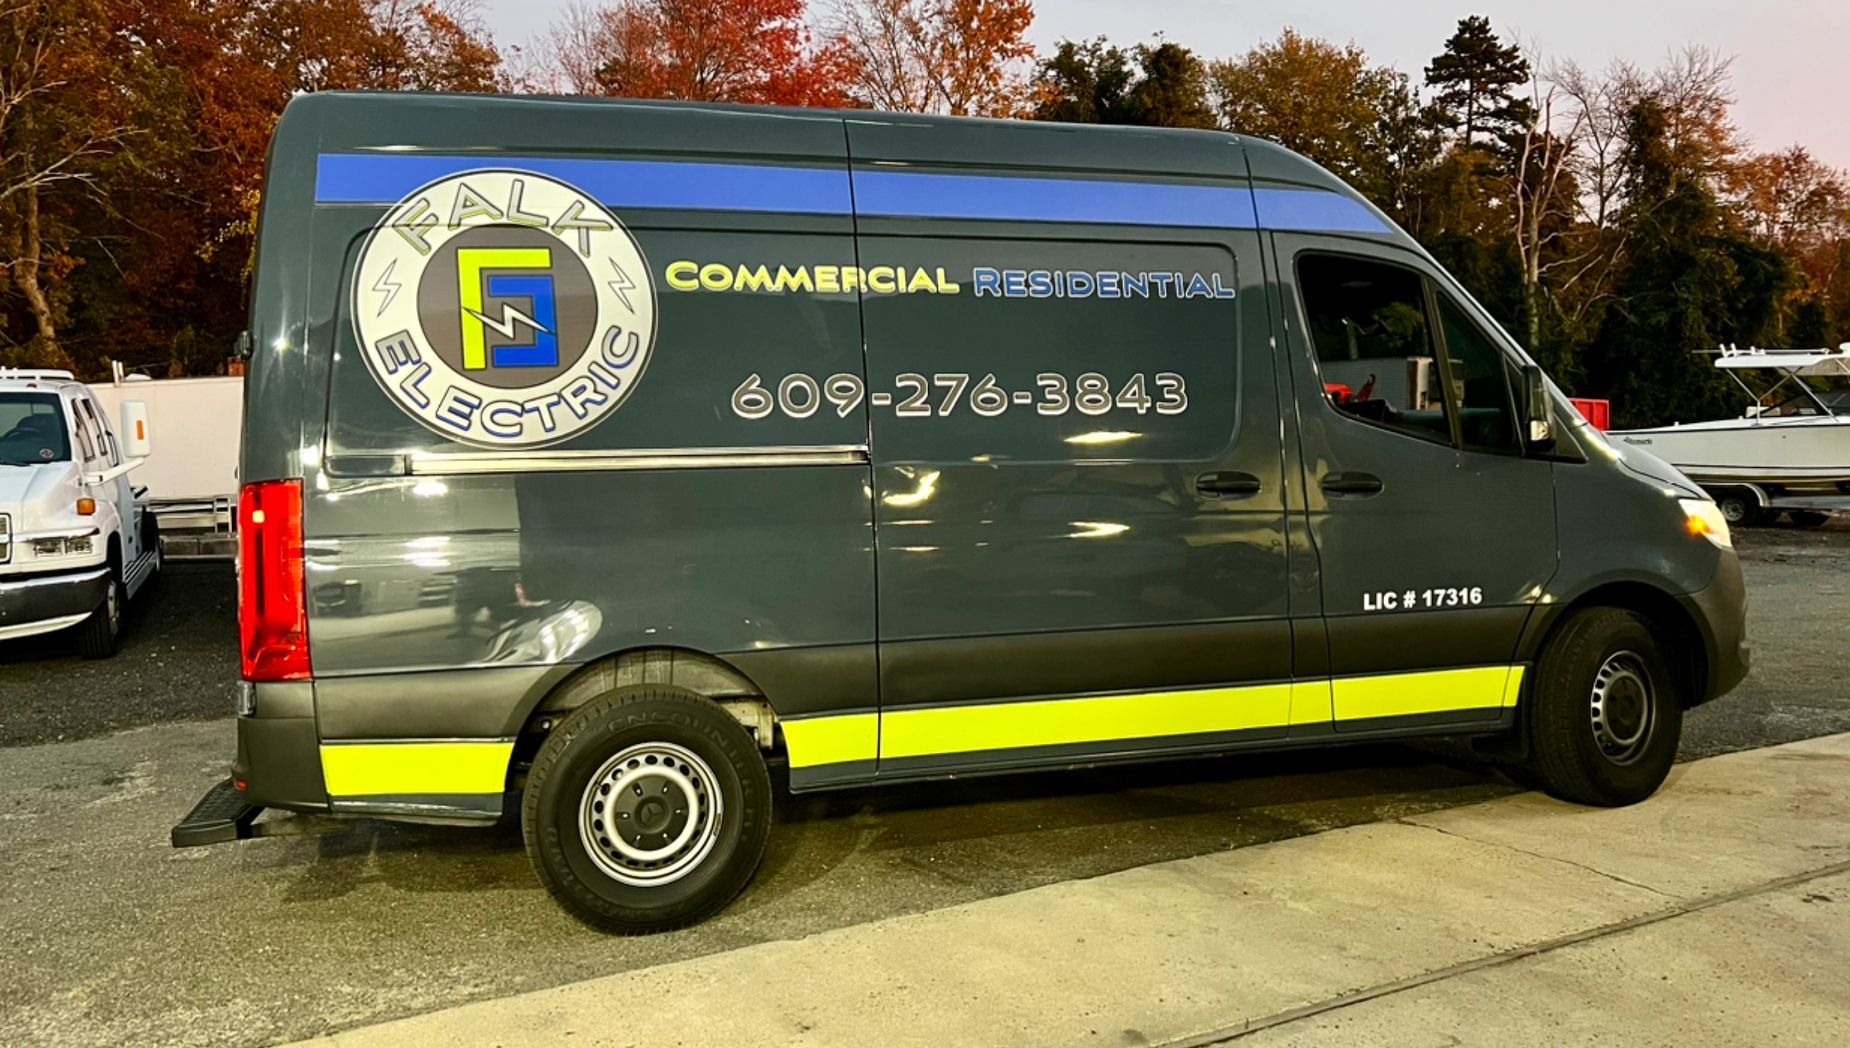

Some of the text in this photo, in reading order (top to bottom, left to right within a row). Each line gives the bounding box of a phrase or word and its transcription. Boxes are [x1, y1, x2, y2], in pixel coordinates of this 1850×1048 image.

[392, 178, 613, 258] FALK
[665, 260, 1236, 300] COMMERCIAL RESIDENTIAL
[375, 325, 639, 437] ELECTRIC
[731, 373, 1188, 420] 609-276-3843
[1363, 587, 1483, 611] LIC # 17316
